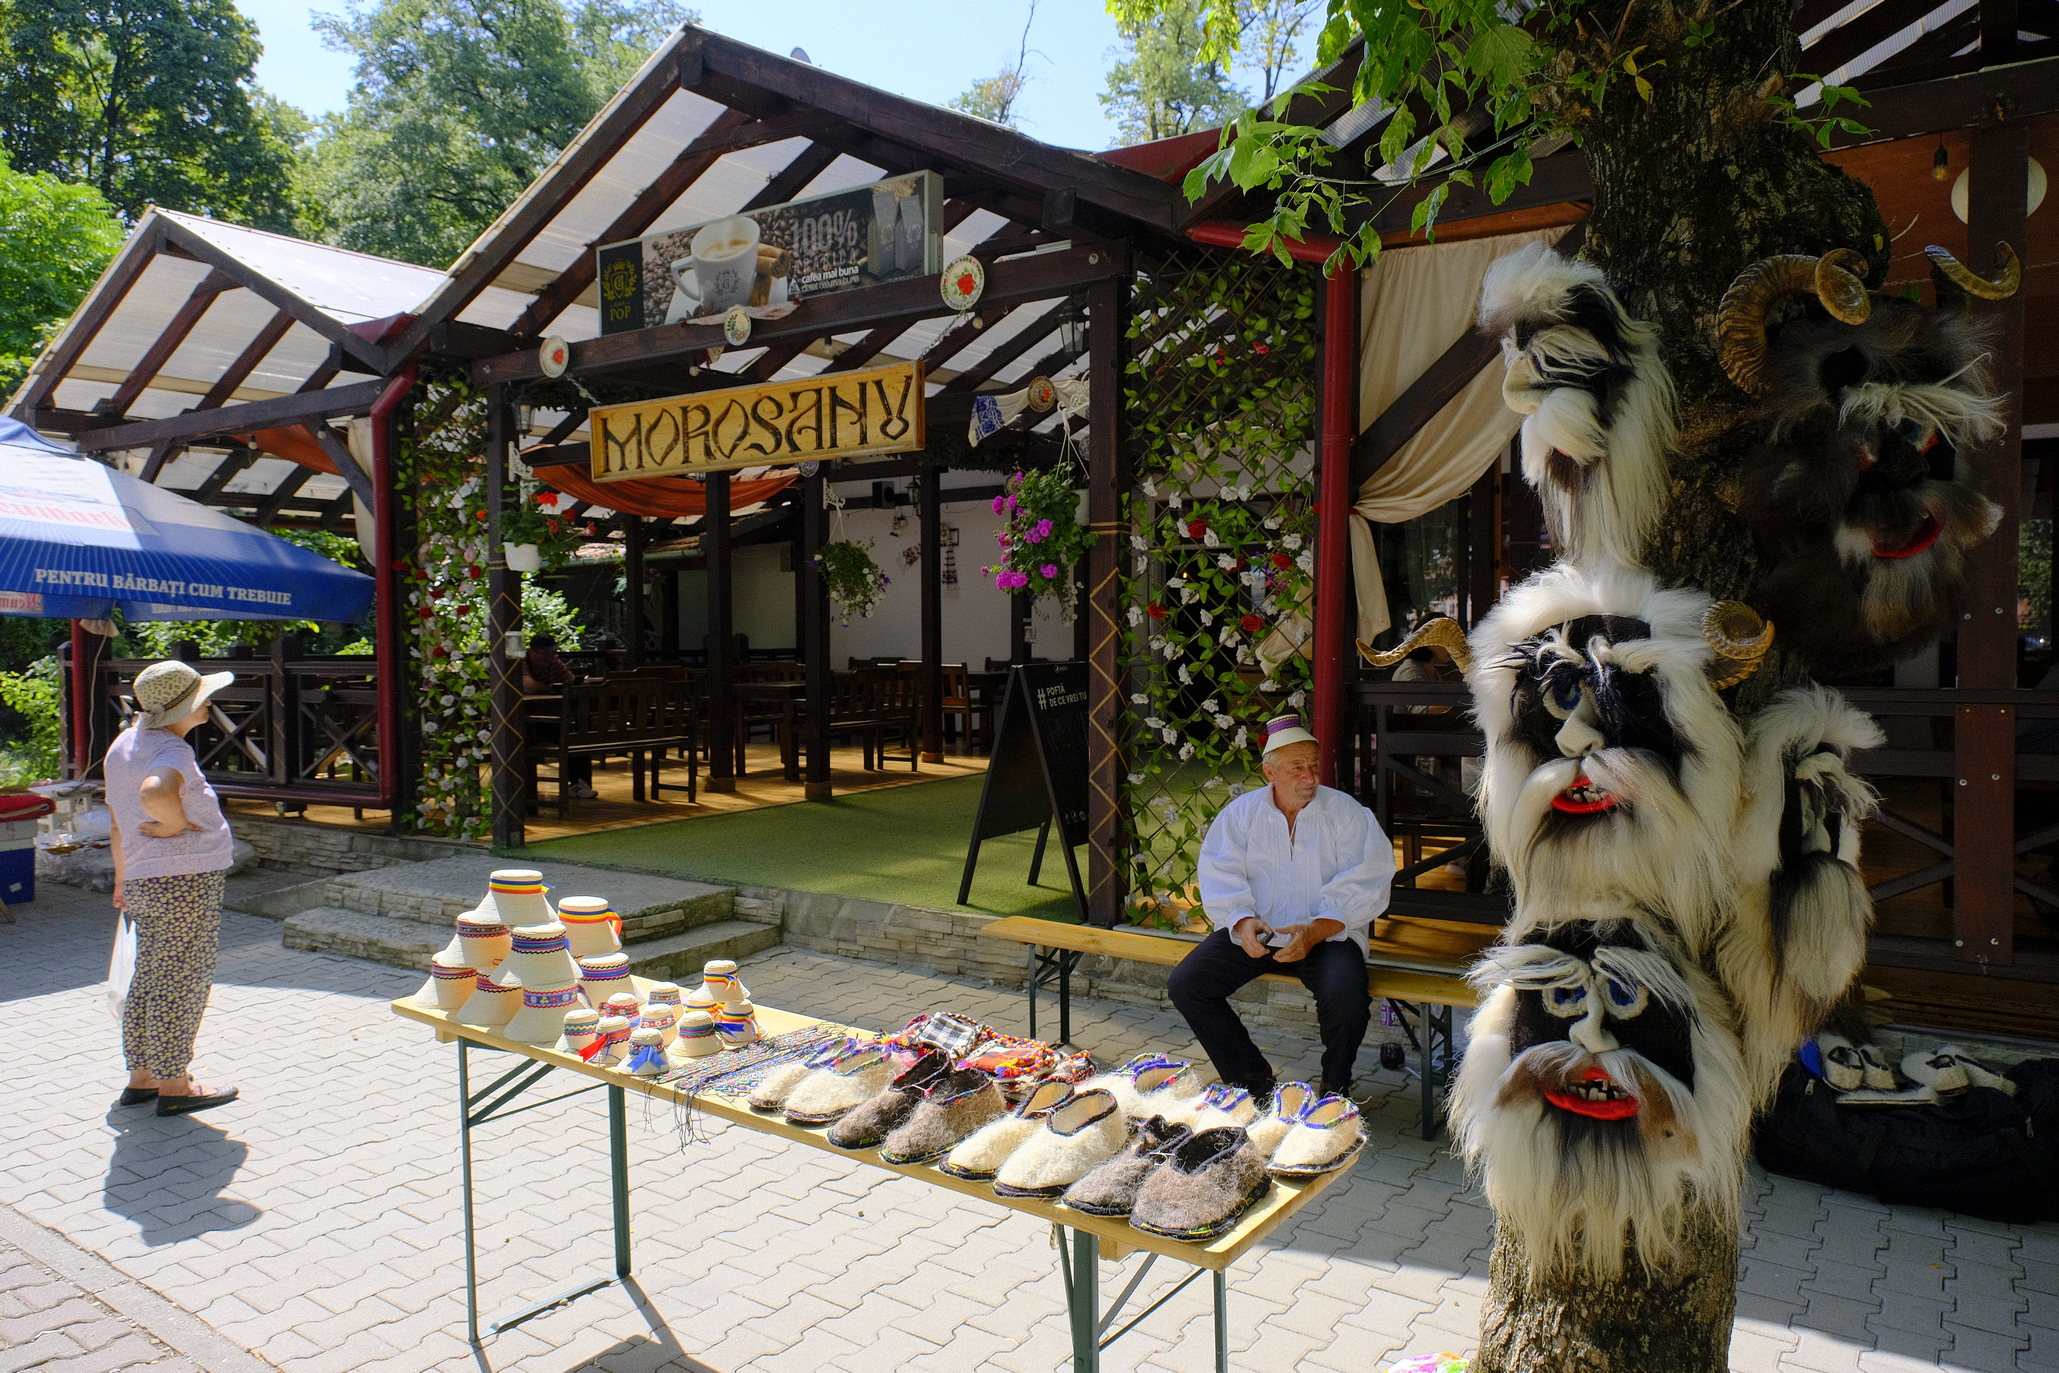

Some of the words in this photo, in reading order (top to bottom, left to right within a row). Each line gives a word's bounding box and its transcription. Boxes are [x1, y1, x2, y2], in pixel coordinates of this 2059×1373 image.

[789, 209, 858, 258] 100%
[801, 272, 822, 284] cafea
[822, 268, 837, 281] mai
[610, 305, 631, 321] POP
[35, 568, 108, 588] PENTRU
[188, 582, 224, 599] CUM
[227, 586, 292, 605] TREBUIE
[1049, 697, 1058, 707] DE
[1058, 695, 1066, 705] CE
